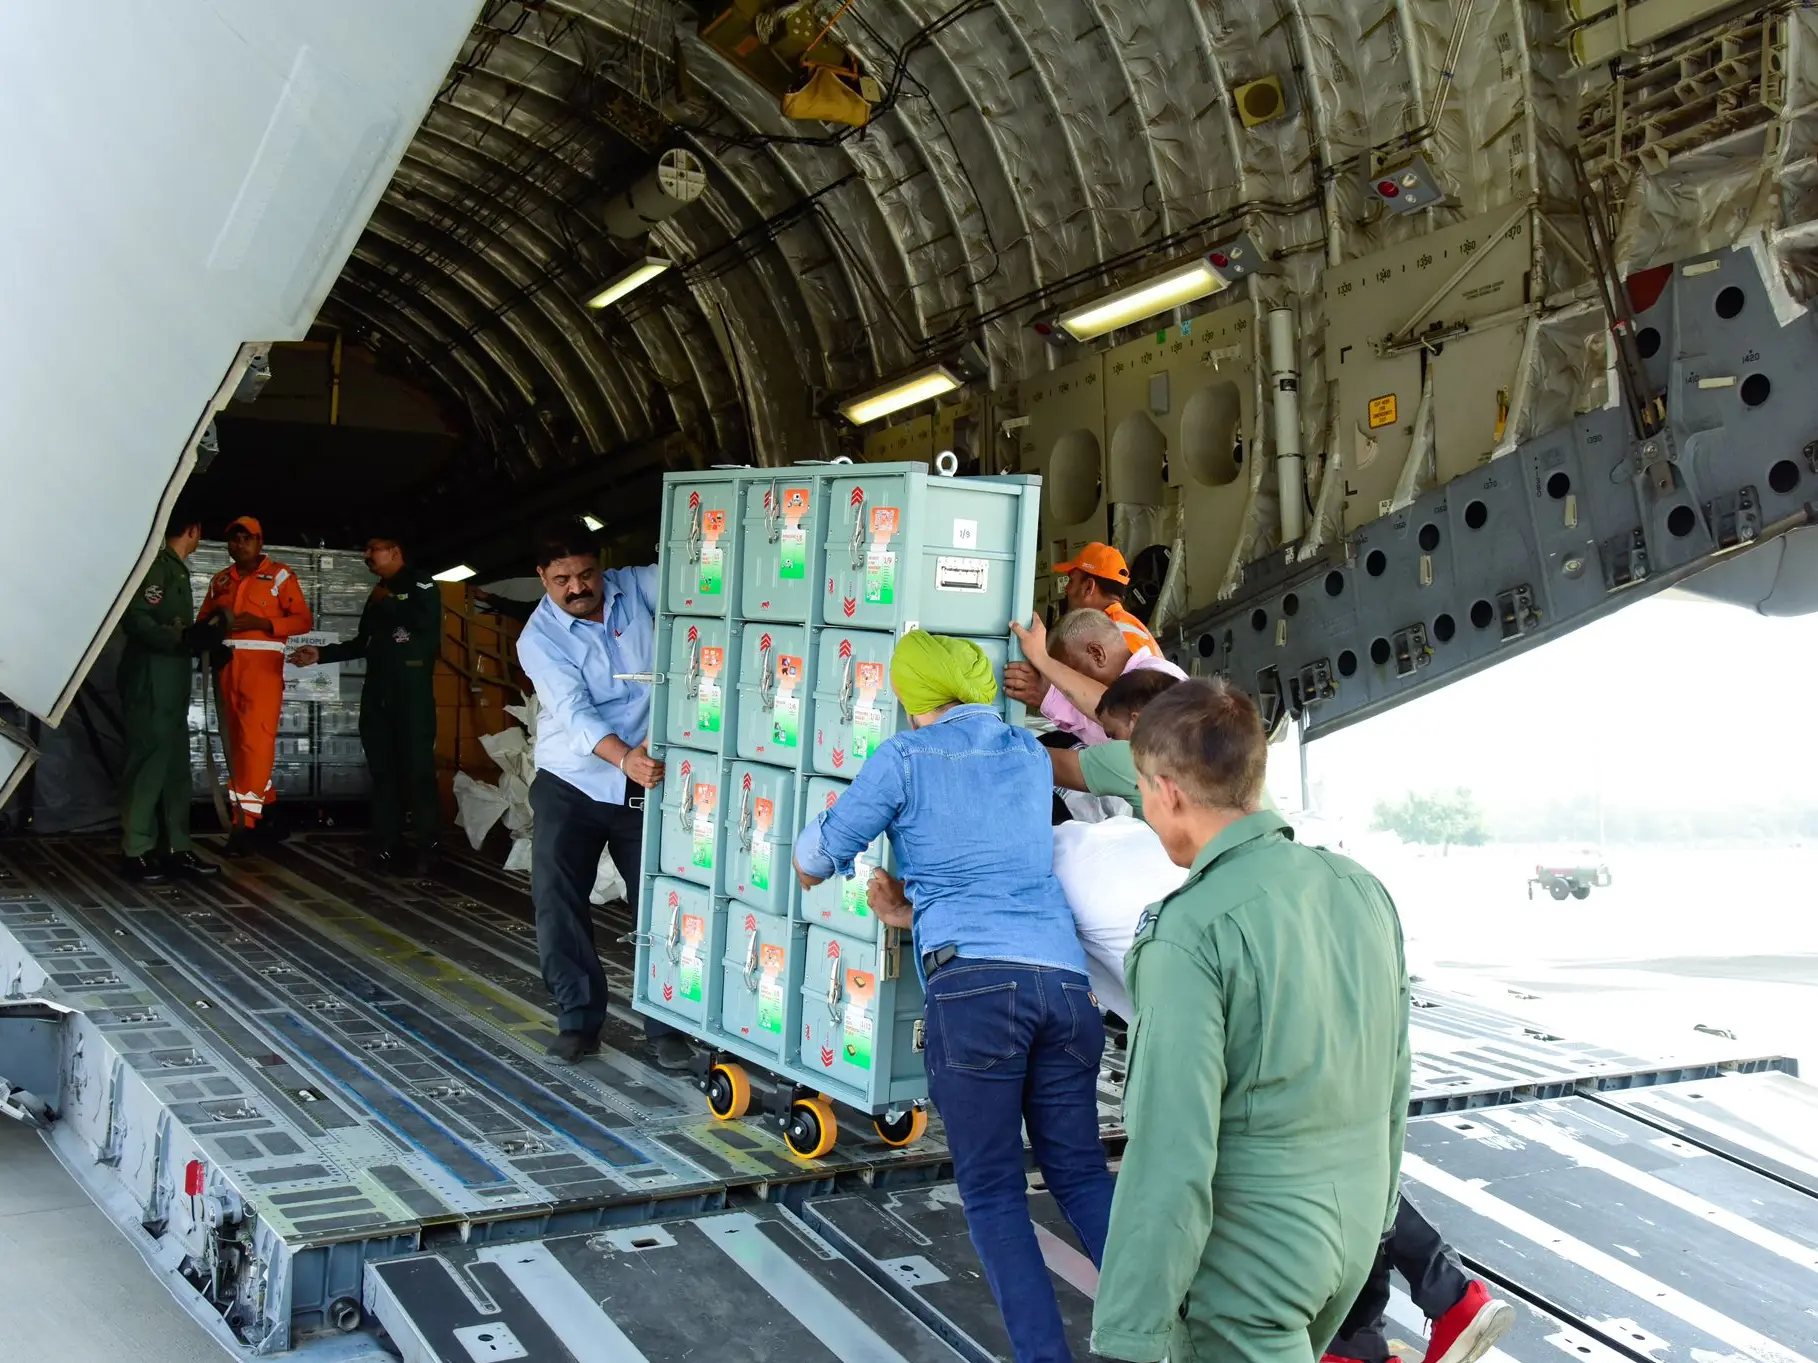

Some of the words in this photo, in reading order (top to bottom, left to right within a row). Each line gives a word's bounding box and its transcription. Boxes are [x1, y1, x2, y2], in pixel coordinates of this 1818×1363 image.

[1338, 283, 1352, 294] 1330
[1376, 270, 1391, 282] 1340
[1416, 255, 1432, 268] 1350
[1460, 240, 1476, 254] 1360
[1742, 352, 1760, 364] 1420
[960, 528, 971, 540] 1/9
[884, 556, 893, 565] 1/9
